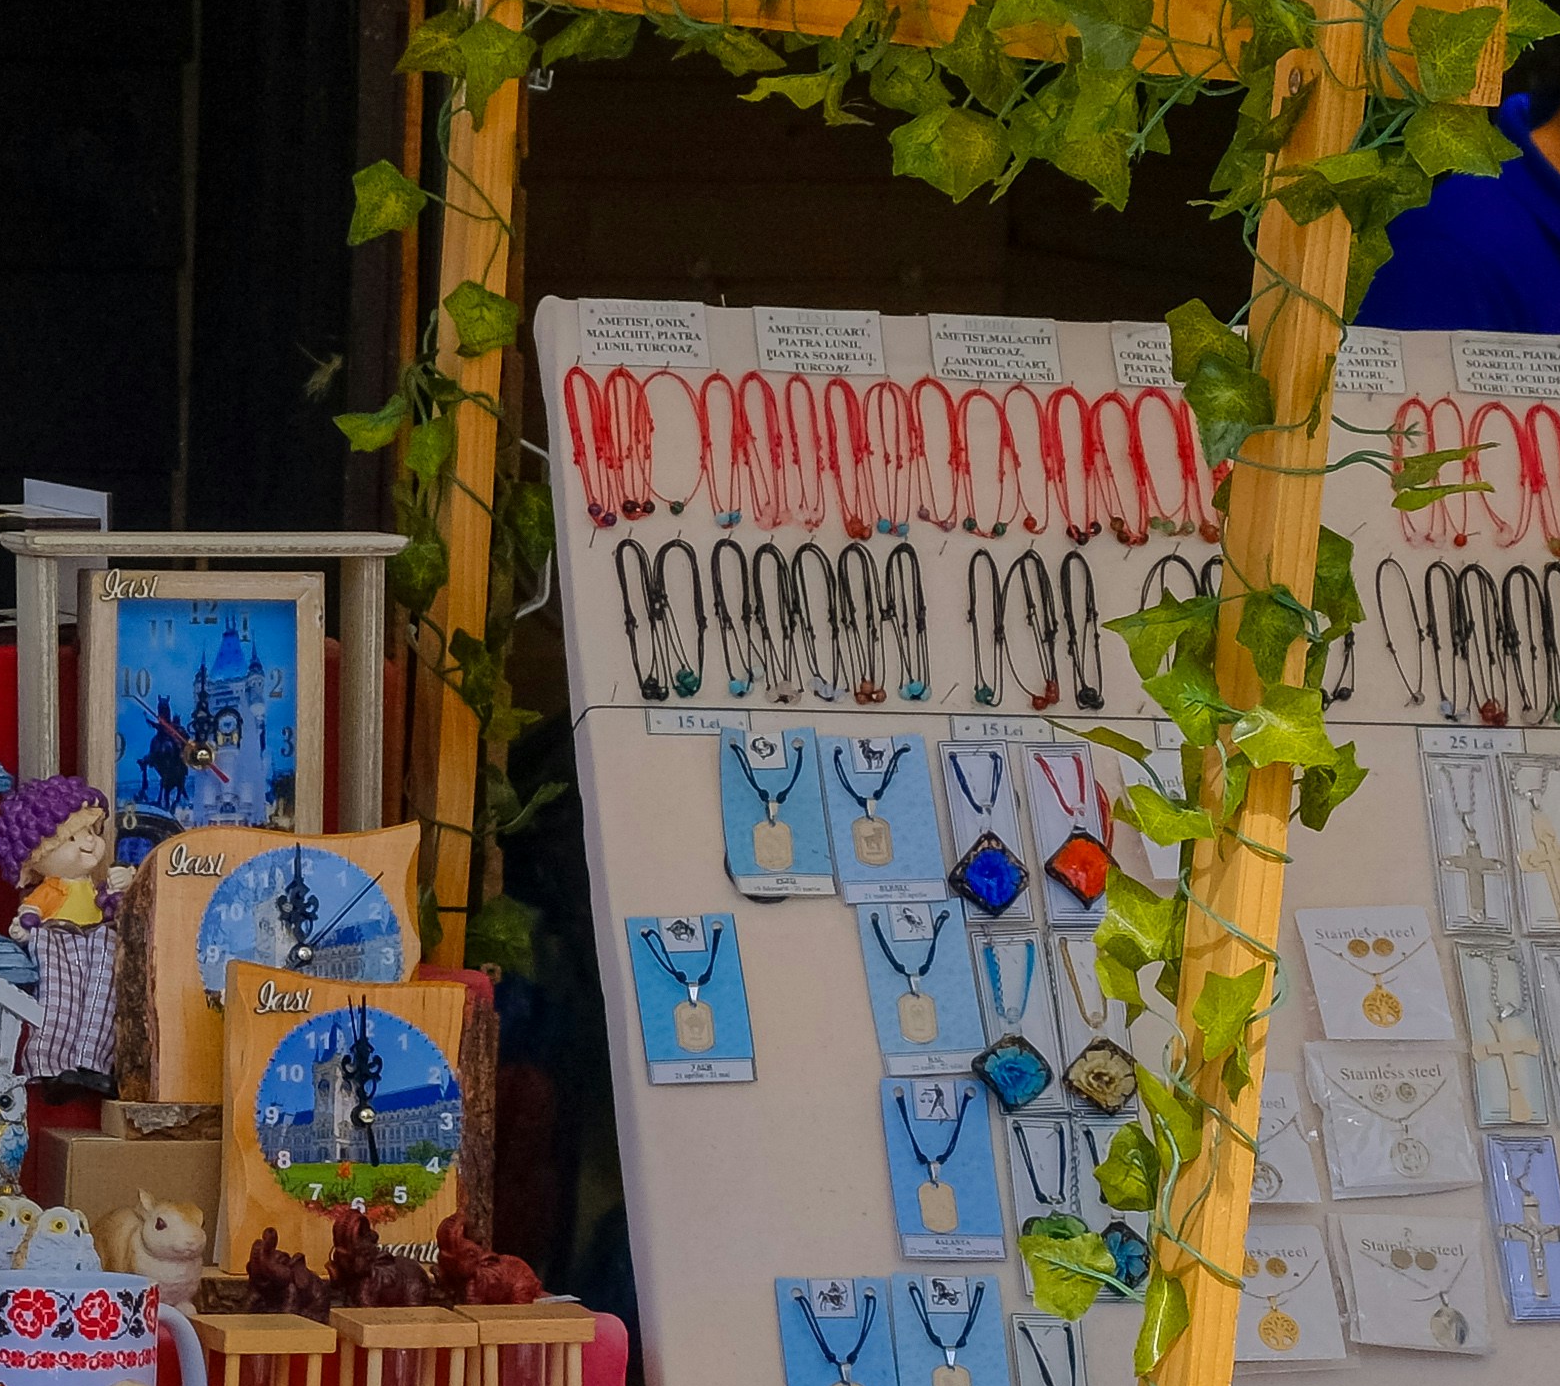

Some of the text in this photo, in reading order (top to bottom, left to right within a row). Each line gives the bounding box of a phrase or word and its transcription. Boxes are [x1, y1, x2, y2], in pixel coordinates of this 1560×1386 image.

[597, 316, 653, 328] AMETIST,
[657, 331, 701, 341] PIATRA
[101, 568, 159, 601] Iasi
[679, 716, 695, 728] 15
[982, 722, 1024, 736] 15 Lei
[1450, 735, 1494, 750] 25 Lei
[166, 843, 224, 877] Iasi
[255, 980, 312, 1014] Iasi
[305, 1033, 330, 1050] 11
[398, 1033, 409, 1050] 1
[277, 1064, 304, 1082] 10
[1340, 1064, 1443, 1081] Stainless steel
[264, 1107, 278, 1124] 9
[440, 1113, 454, 1130] 3
[277, 1151, 292, 1169] 8
[426, 1156, 441, 1173] 4
[309, 1183, 323, 1199] 7
[393, 1186, 408, 1203] 5
[1431, 1244, 1465, 1258] steel
